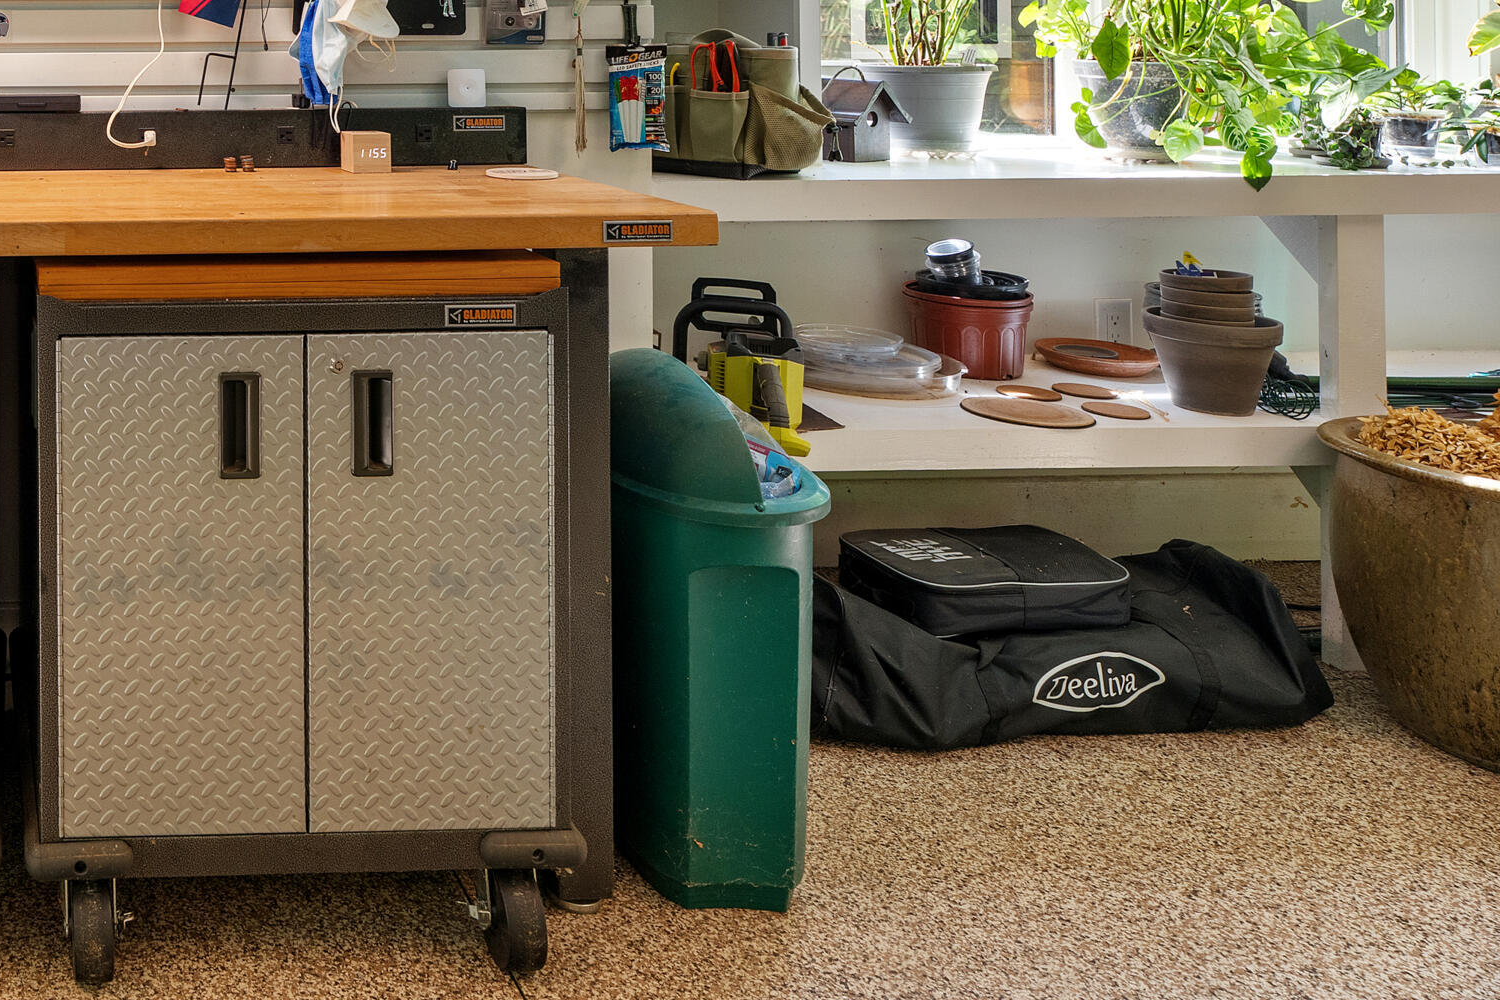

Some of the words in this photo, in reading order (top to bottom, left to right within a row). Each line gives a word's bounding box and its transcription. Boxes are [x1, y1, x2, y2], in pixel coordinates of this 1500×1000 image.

[612, 55, 629, 64] LIFE
[638, 50, 662, 60] GEAR
[466, 118, 503, 127] GLADIATOR
[621, 225, 670, 235] GLADIATOR
[463, 309, 513, 320] GLADIATOR
